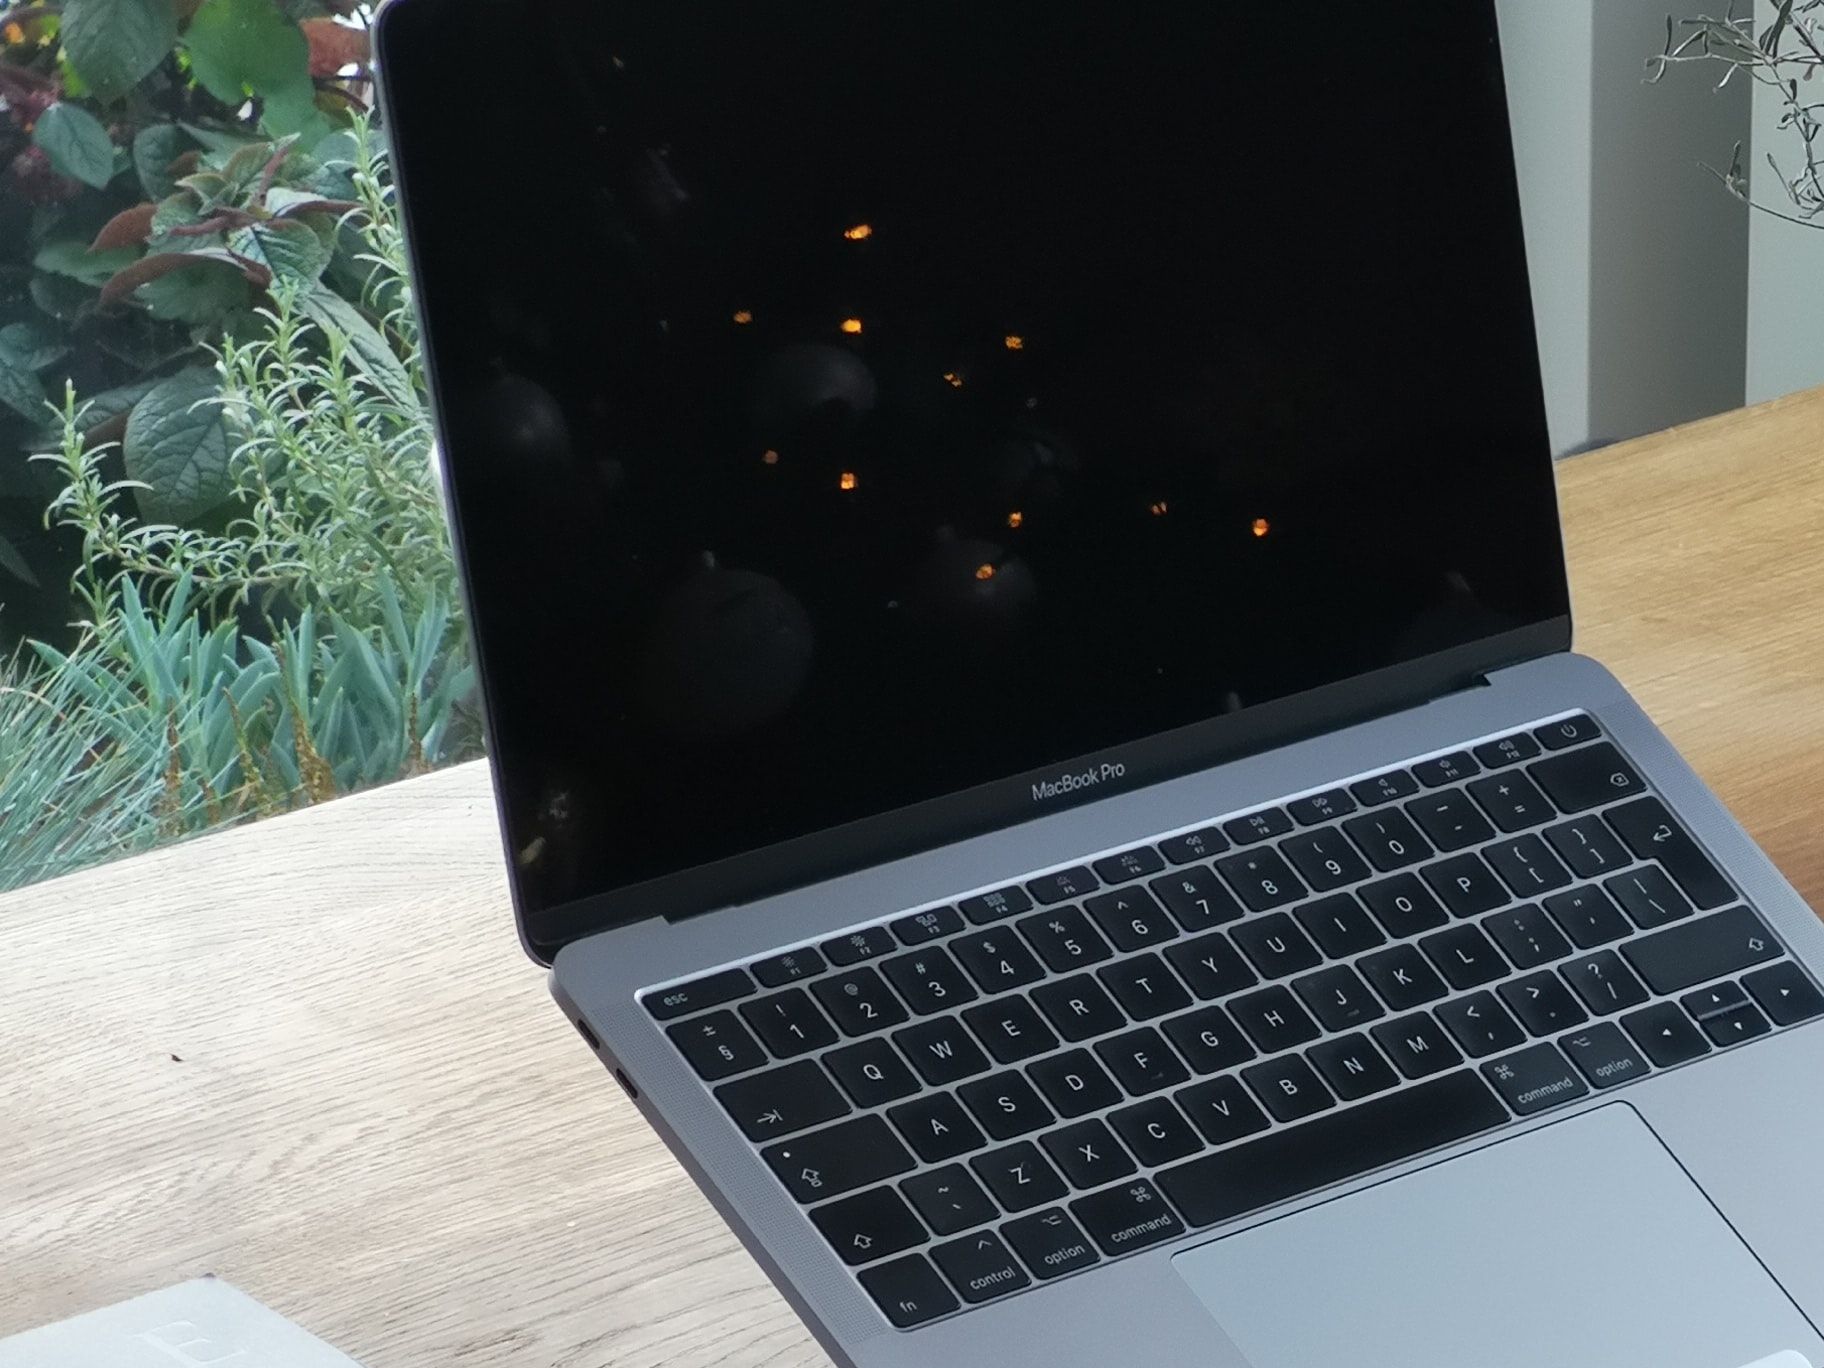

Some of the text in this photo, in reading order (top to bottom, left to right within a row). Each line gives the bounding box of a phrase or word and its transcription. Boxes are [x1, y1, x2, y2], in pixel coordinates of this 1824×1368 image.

[1032, 764, 1125, 800] MacBook Pro
[1389, 840, 1404, 854] 0
[1326, 860, 1341, 874] 9
[1182, 882, 1196, 893] &
[1262, 880, 1278, 894] 8
[1457, 878, 1470, 892] P
[1196, 900, 1209, 914] 7
[1396, 897, 1412, 912] O
[1132, 920, 1148, 934] 6
[1065, 940, 1081, 954] 5
[1267, 937, 1285, 952] U
[1456, 950, 1474, 963] L
[916, 963, 925, 974] #
[1001, 961, 1014, 974] 4
[1202, 958, 1217, 972] Y
[1393, 969, 1412, 984] K
[929, 982, 946, 996] 3
[1136, 978, 1152, 993] T
[664, 993, 688, 1006] esc
[1336, 990, 1346, 1004] J
[860, 1003, 878, 1018] 2
[1070, 1000, 1088, 1015] R
[1264, 1010, 1284, 1026] H
[790, 1024, 804, 1038] 1
[1002, 1020, 1020, 1036] E
[1201, 1032, 1218, 1046] G
[1407, 1036, 1428, 1053] M
[930, 1041, 952, 1058] W
[1134, 1053, 1147, 1068] F
[1344, 1058, 1364, 1074] N
[1596, 1059, 1632, 1076] option
[864, 1064, 883, 1079] Q
[1066, 1075, 1083, 1090] D
[1279, 1080, 1297, 1094] B
[1518, 1077, 1573, 1103] command
[998, 1097, 1016, 1112] S
[1212, 1100, 1229, 1115] V
[932, 1119, 948, 1134] A
[1148, 1124, 1165, 1138] C
[1079, 1145, 1099, 1162] X
[1010, 1168, 1030, 1184] Z
[1112, 1214, 1172, 1242] command
[1045, 1246, 1085, 1264] option
[970, 1266, 1015, 1289] control
